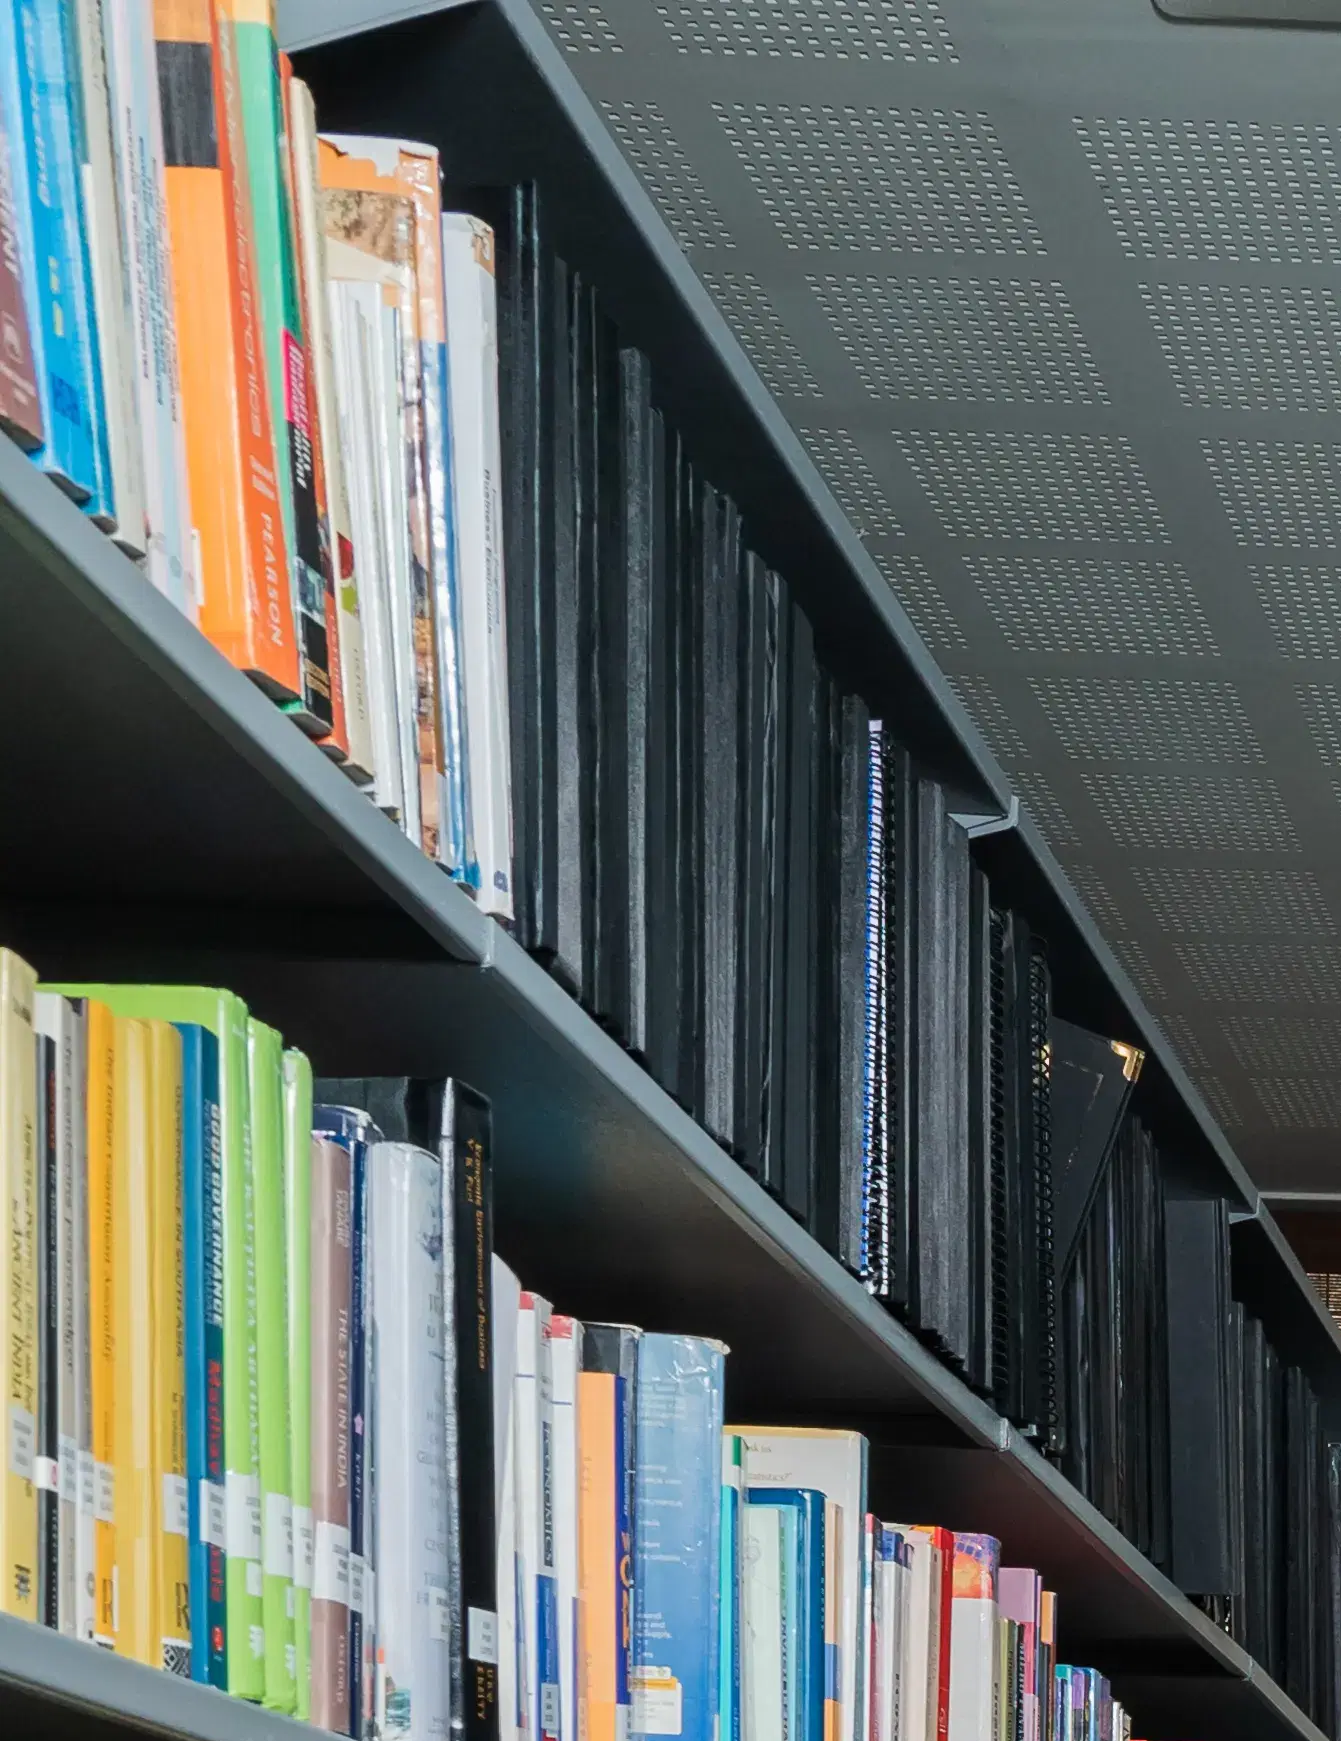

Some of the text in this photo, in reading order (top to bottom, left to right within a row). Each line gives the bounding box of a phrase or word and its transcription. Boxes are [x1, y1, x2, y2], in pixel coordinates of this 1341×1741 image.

[260, 512, 283, 647] PEARSON
[337, 1307, 349, 1489] THE STATE IN INDIA
